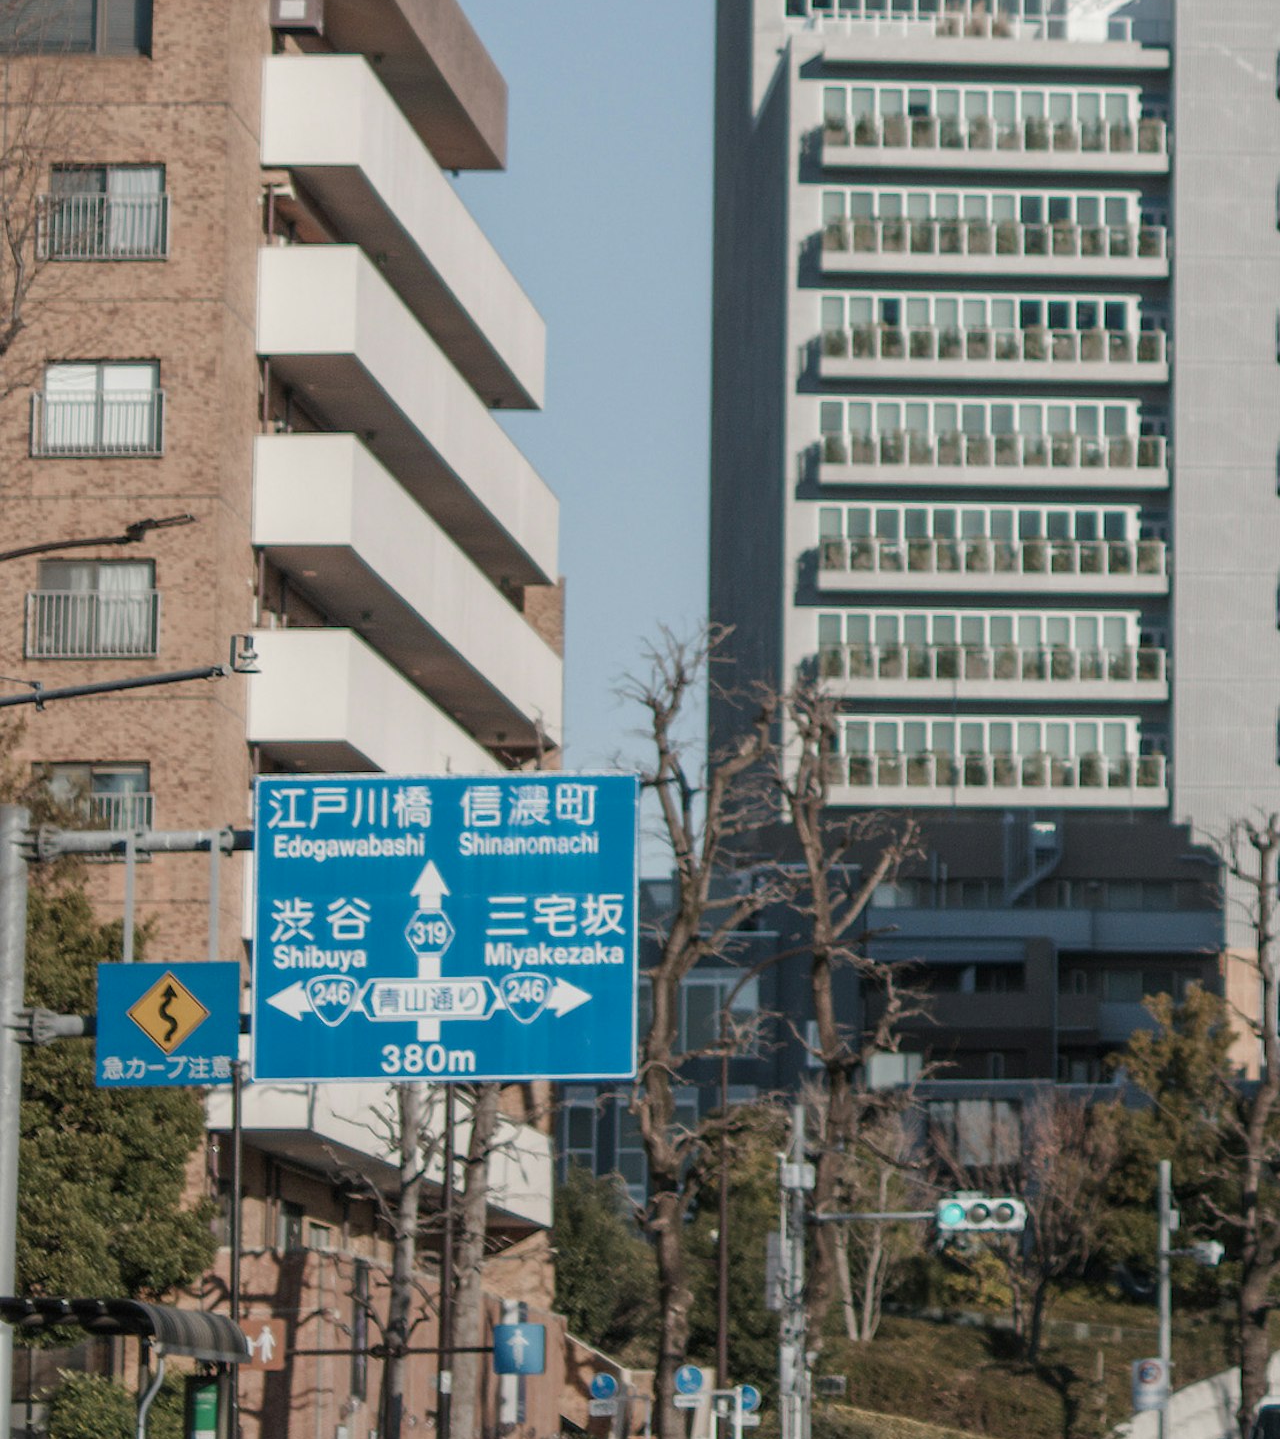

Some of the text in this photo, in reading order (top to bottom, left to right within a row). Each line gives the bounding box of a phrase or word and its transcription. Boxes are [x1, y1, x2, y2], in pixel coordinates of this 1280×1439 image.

[267, 786, 433, 829] 江戸川橋
[459, 783, 598, 827] 信濃町
[273, 833, 426, 862] Edogawabashi
[459, 830, 600, 856] Shinanomachi
[270, 897, 372, 943] 渋谷
[485, 894, 627, 938] 三宅坂
[412, 921, 447, 946] 319
[273, 944, 367, 973] Shibuya
[484, 941, 625, 971] Miyakezaka
[312, 982, 352, 1006] 246
[378, 986, 479, 1013] 青山通り
[506, 979, 545, 1003] 246
[380, 1043, 476, 1074] 380m
